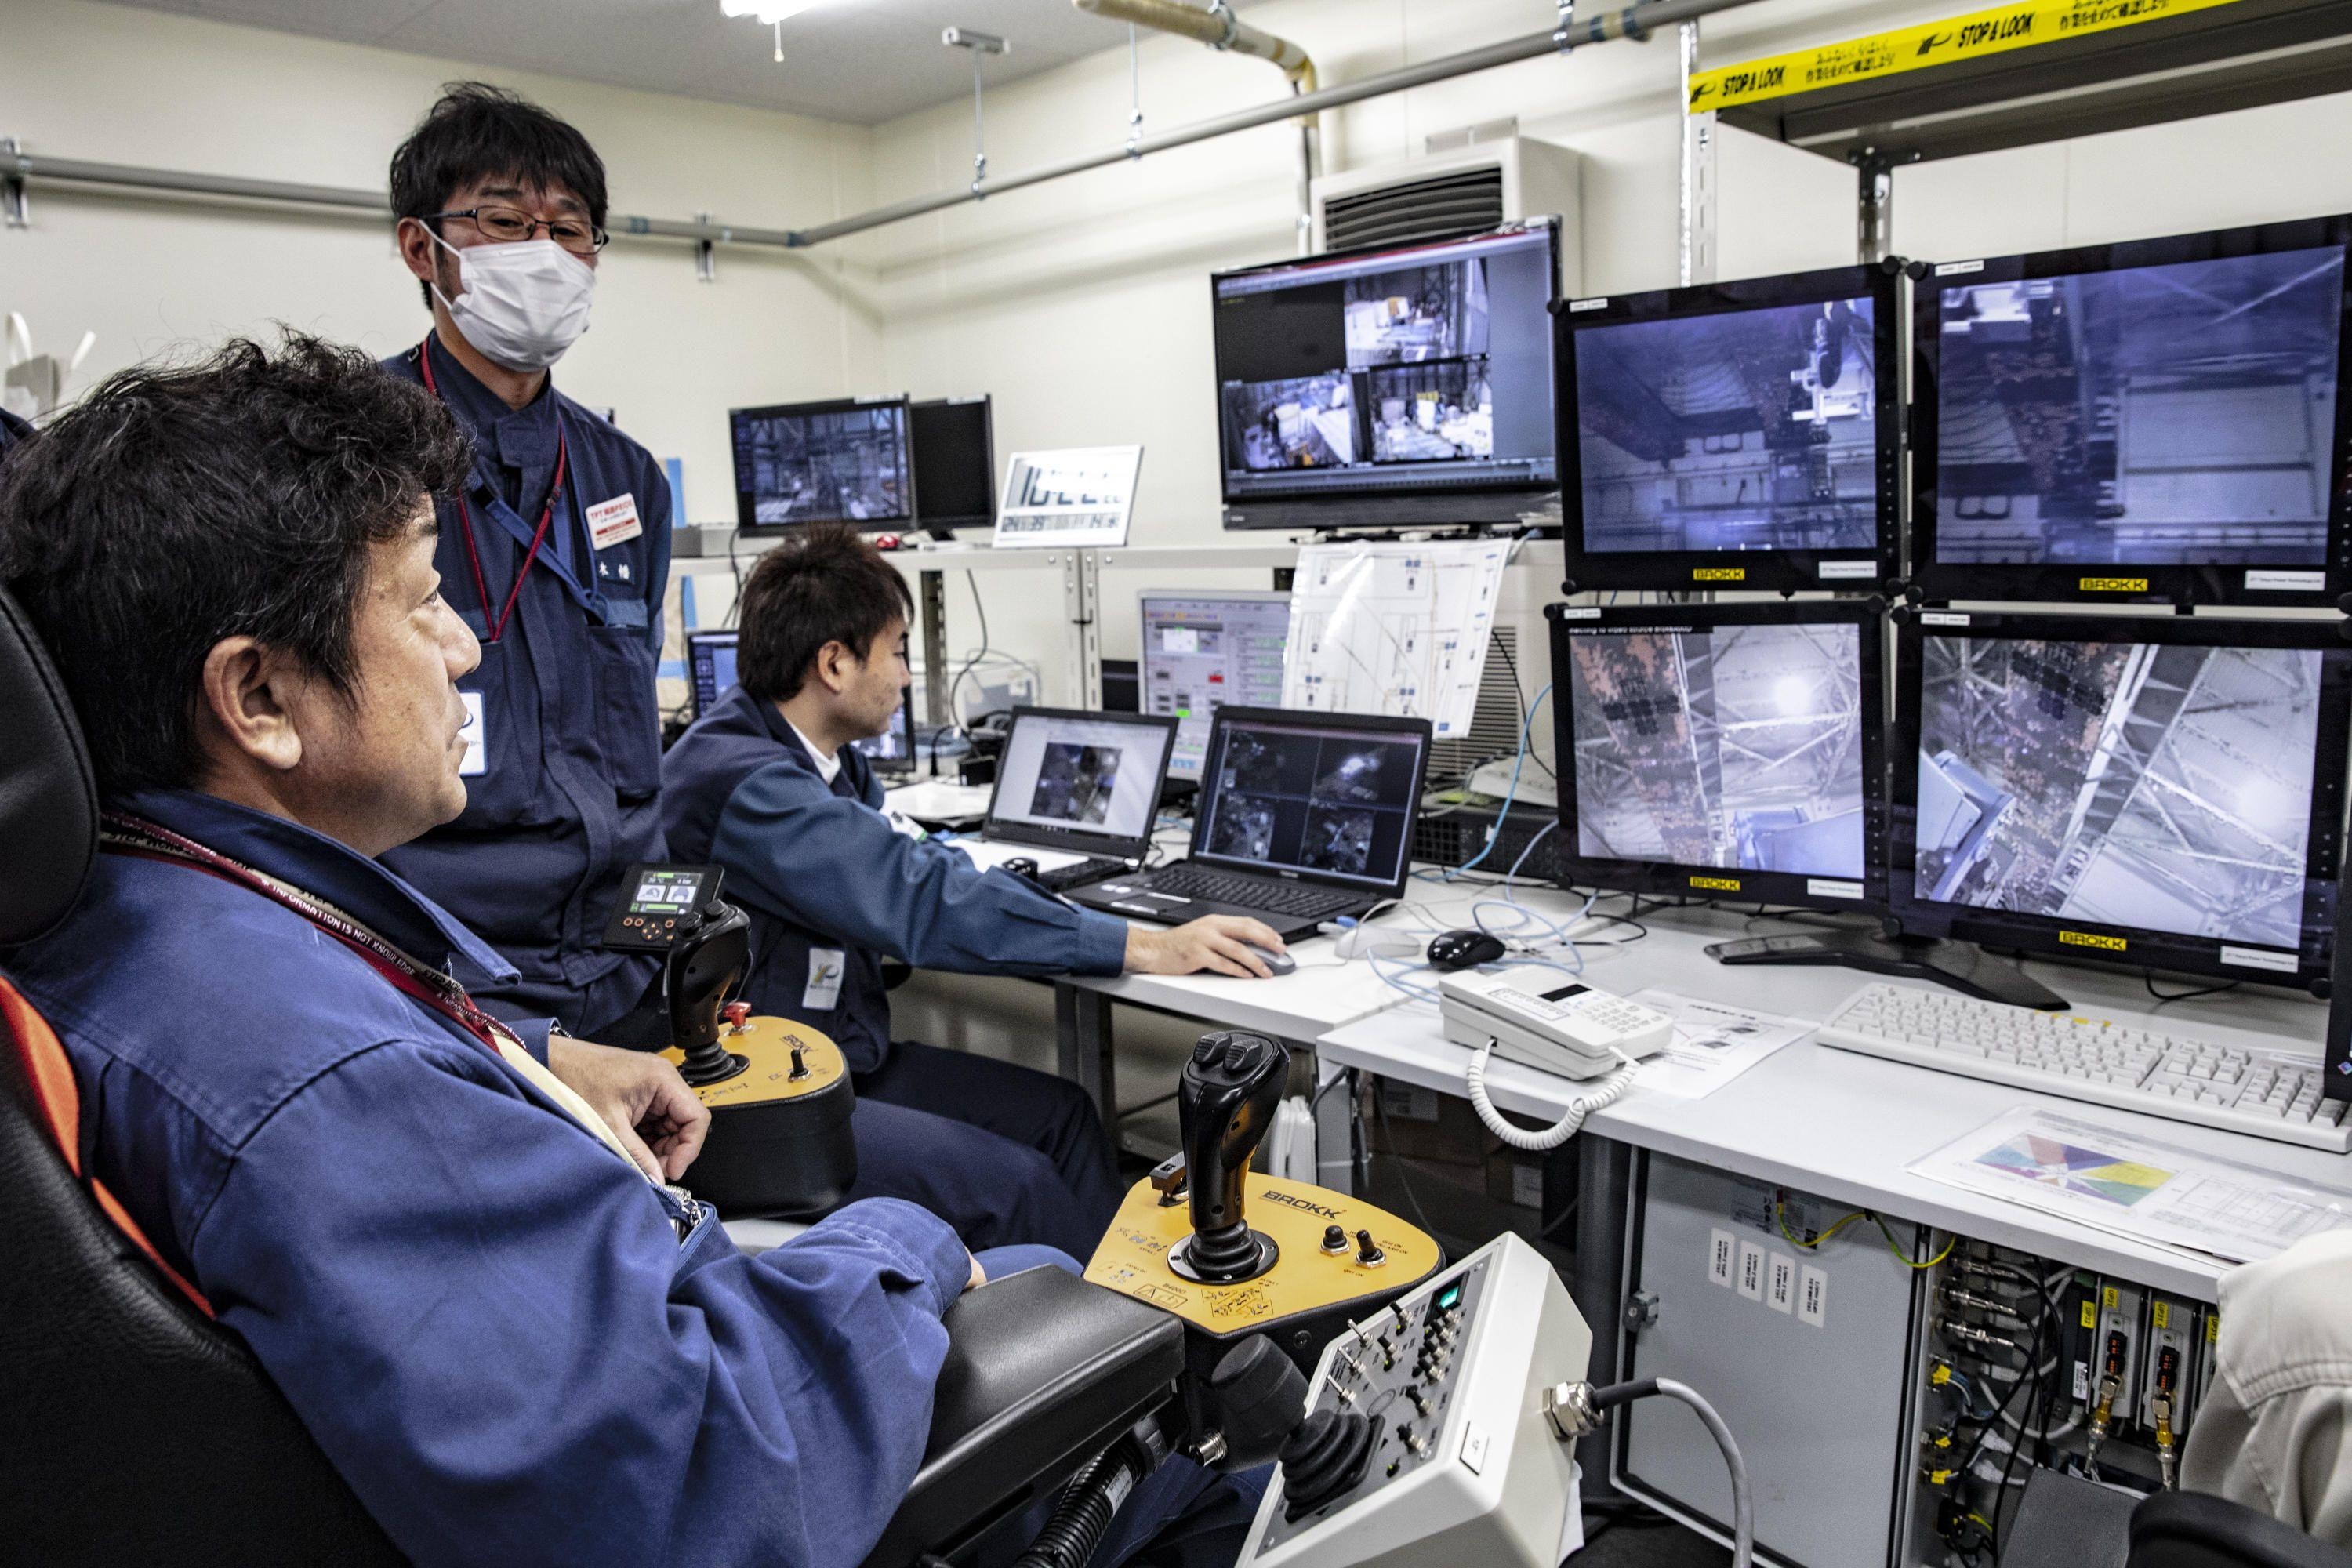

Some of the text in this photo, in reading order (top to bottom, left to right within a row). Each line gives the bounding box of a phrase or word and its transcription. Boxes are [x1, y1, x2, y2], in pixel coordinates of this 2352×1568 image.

[1958, 13, 2034, 48] STOP & LOOK
[1722, 73, 1748, 96] STOP
[1757, 65, 1787, 89] LOOK
[2083, 579, 2145, 590] BROKK
[273, 886, 416, 976] INFORMATION IS NOT KNOWLEDGE
[2063, 932, 2125, 949] BROKK
[1263, 1189, 1341, 1220] BROKK
